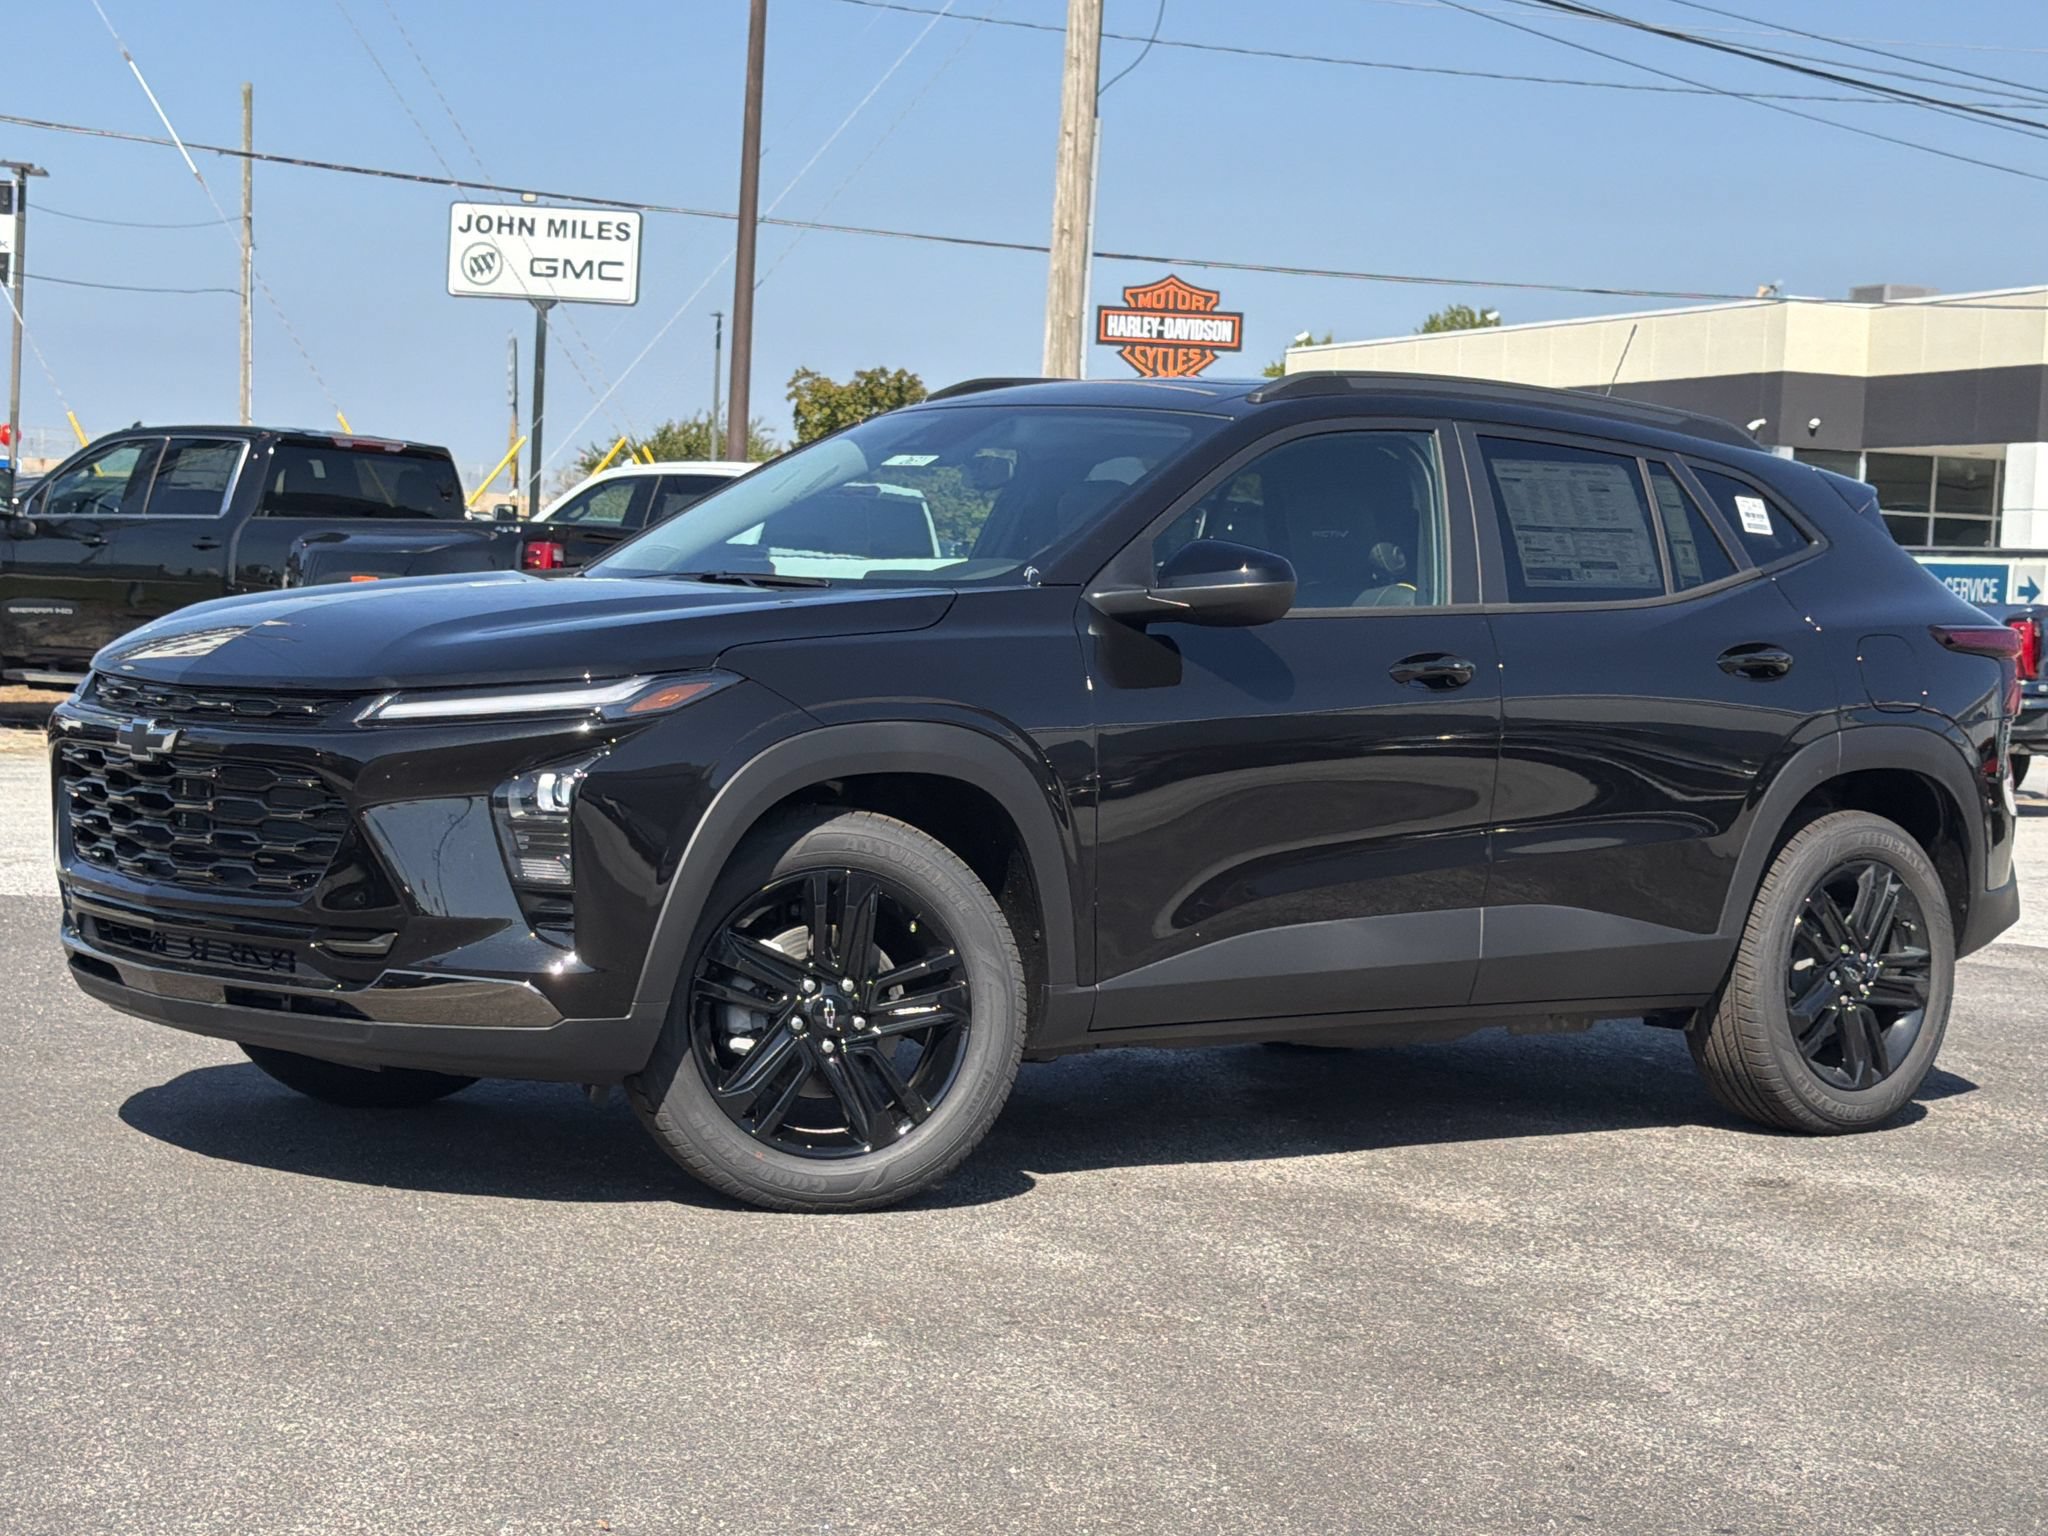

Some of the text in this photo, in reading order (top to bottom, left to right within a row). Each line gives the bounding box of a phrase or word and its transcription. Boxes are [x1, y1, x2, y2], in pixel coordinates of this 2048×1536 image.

[457, 213, 631, 241] JOHN MILES
[529, 257, 625, 282] GMC
[1137, 283, 1206, 311] MOTOR
[1107, 314, 1233, 342] HARLEY-DAVIDSON
[1134, 345, 1201, 377] CYCLES
